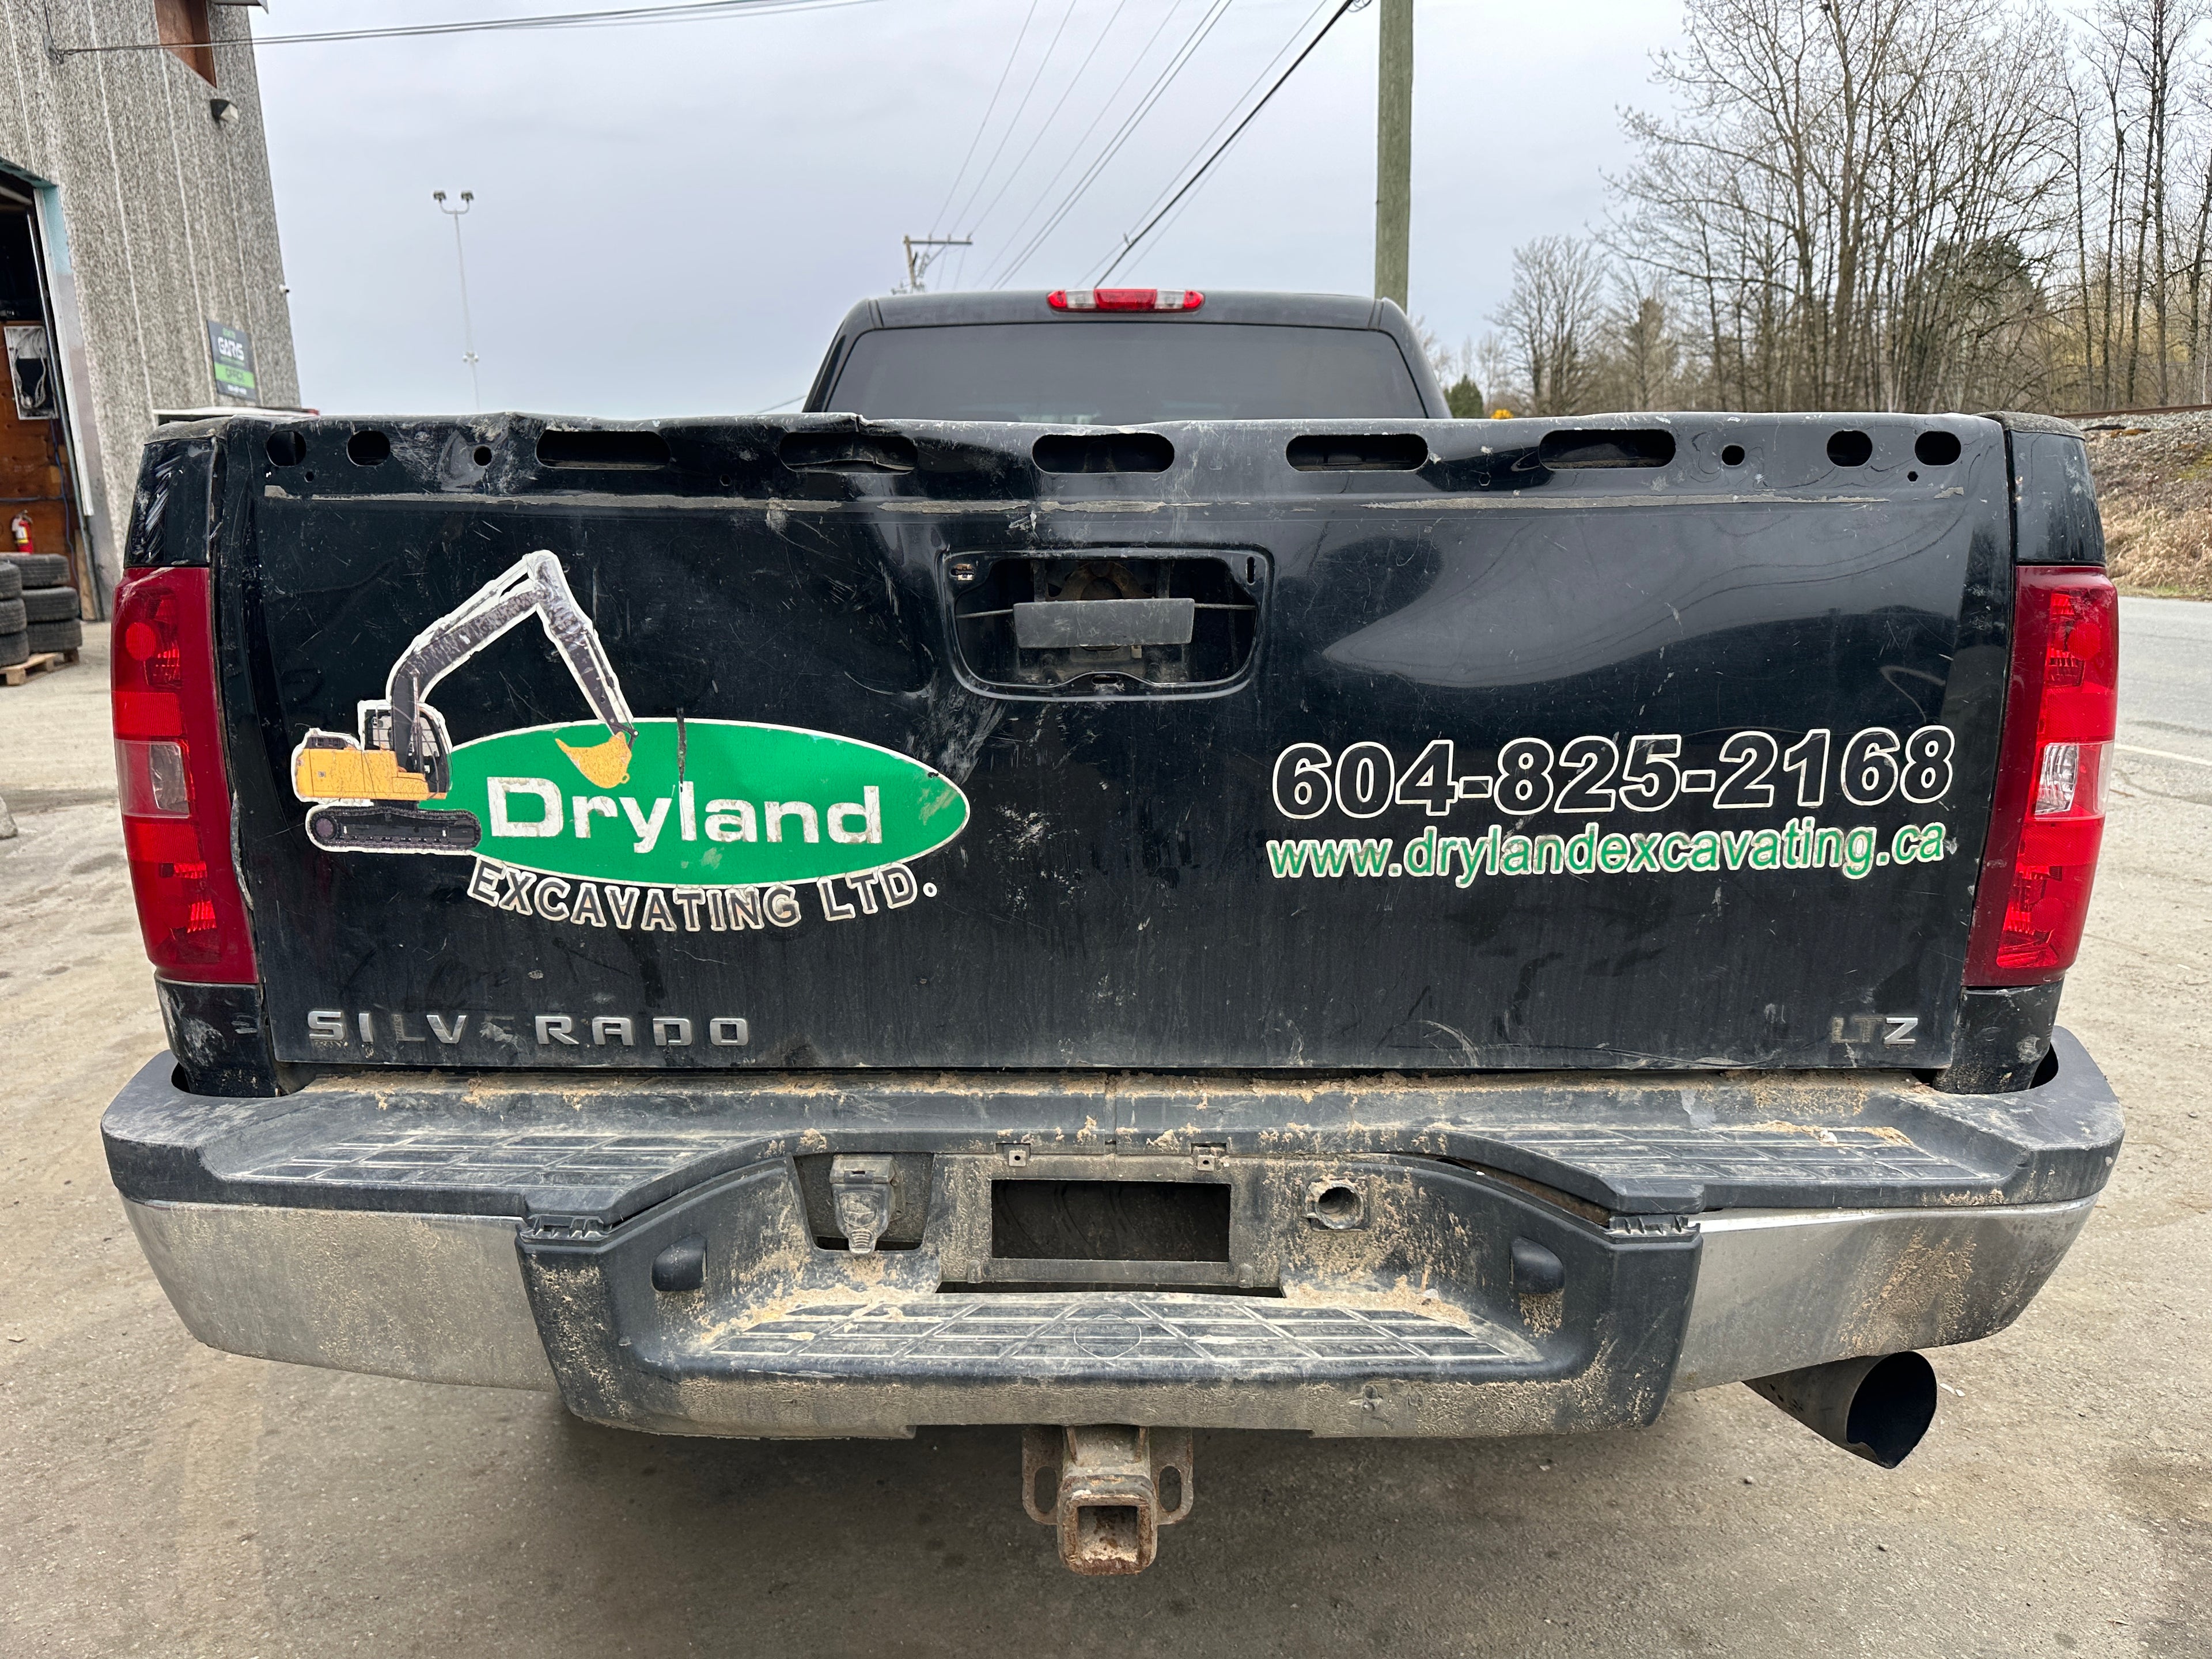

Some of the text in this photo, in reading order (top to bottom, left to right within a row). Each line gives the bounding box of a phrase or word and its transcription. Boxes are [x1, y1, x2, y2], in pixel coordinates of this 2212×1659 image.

[1272, 725, 1956, 820] 604-825-2168
[487, 777, 882, 853] Dryland
[1266, 816, 1946, 889] www.drylandexcavating.ca
[467, 856, 938, 932] EXCAVATING LTD.
[1831, 1016, 1919, 1045] LTZ
